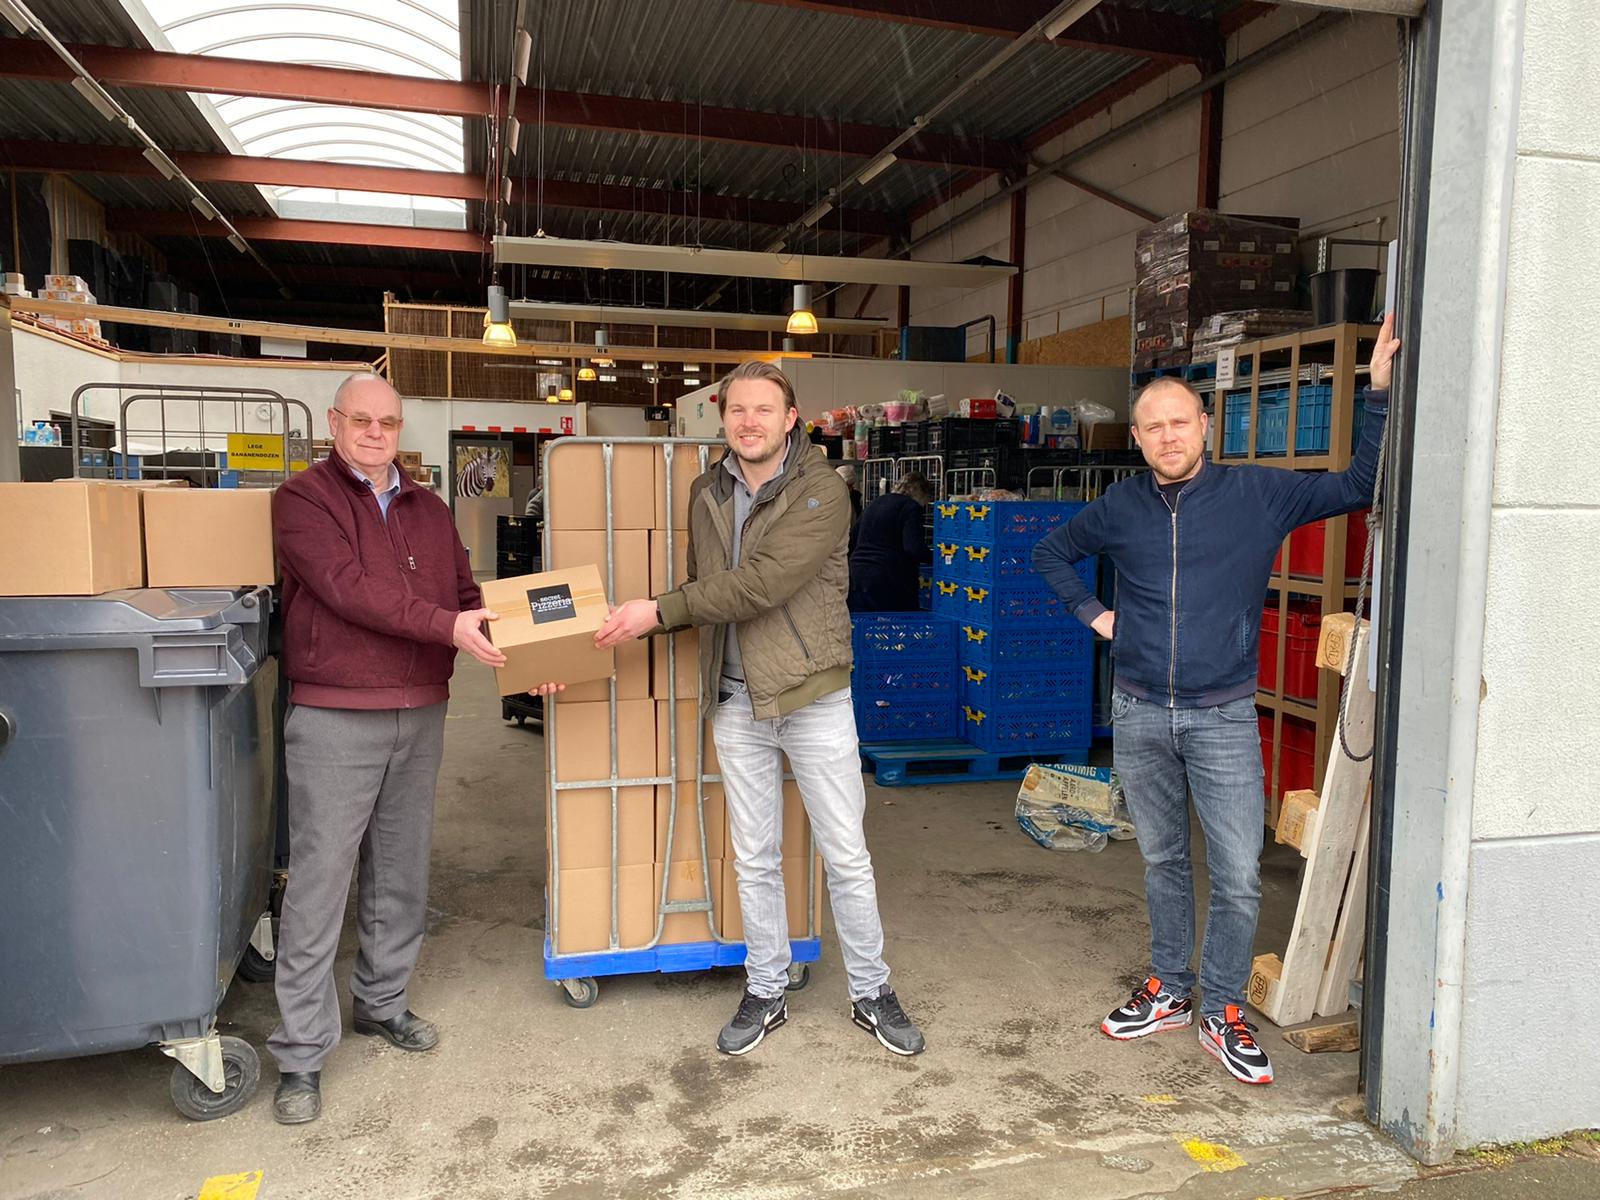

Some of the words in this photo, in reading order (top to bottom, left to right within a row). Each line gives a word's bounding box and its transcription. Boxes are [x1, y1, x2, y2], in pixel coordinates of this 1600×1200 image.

[531, 598, 572, 611] Pizzeria
[540, 594, 561, 602] secret
[1252, 975, 1264, 999] EPAL
